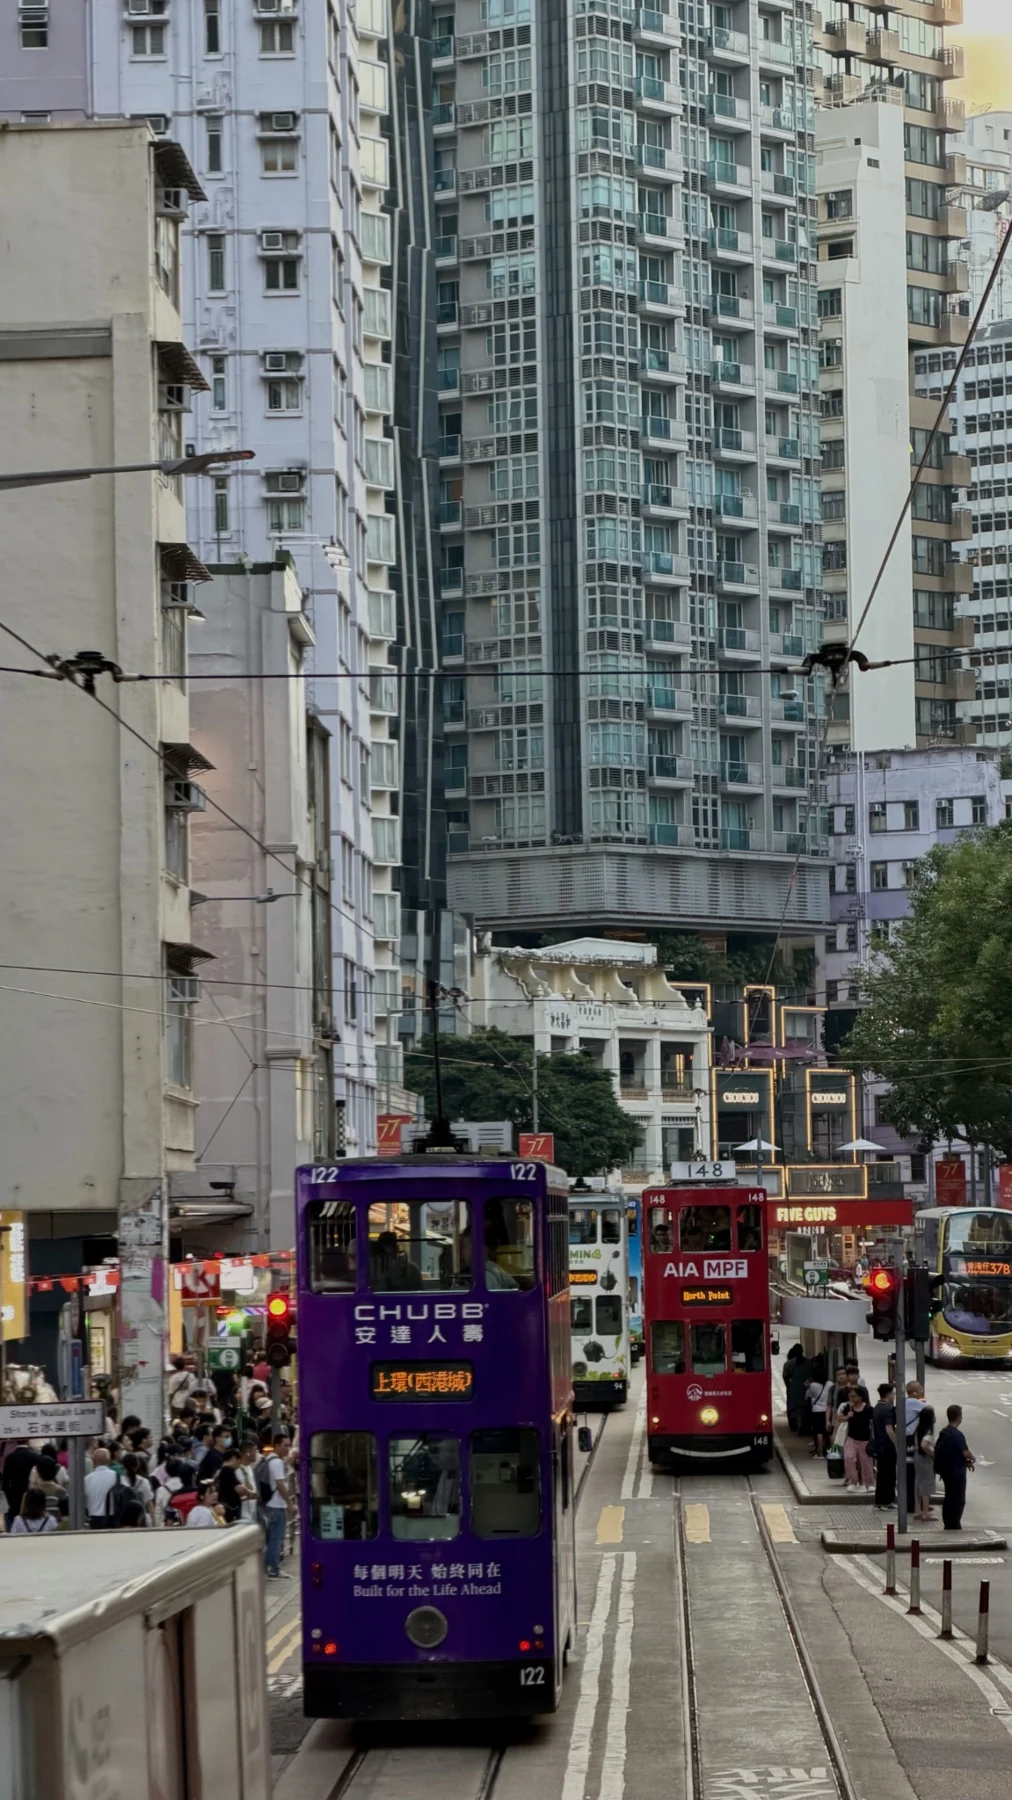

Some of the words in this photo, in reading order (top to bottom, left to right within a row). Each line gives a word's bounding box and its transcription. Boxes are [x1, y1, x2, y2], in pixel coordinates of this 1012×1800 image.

[312, 1166, 339, 1184] 122
[511, 1163, 537, 1181] 122
[688, 1163, 723, 1178] 148
[650, 1195, 666, 1205] 148
[748, 1193, 765, 1203] 148
[777, 1207, 803, 1222] FIVE
[804, 1206, 837, 1222] GUYS
[664, 1262, 699, 1277] AIA
[707, 1262, 745, 1276] MPF
[990, 1263, 1010, 1275] 37B
[683, 1291, 706, 1301] North
[708, 1291, 730, 1301] Point
[354, 1303, 484, 1320] CHUBB
[355, 1324, 484, 1344] 安達人壽
[10, 1410, 38, 1418] Stone
[40, 1408, 72, 1417] Nullah
[73, 1407, 97, 1416] Lane
[753, 1436, 768, 1446] 148
[353, 1564, 423, 1580] 每個明天
[431, 1561, 501, 1579] 始終同在
[353, 1585, 383, 1597] Built
[386, 1584, 406, 1597] for
[408, 1583, 430, 1597] the
[433, 1583, 458, 1596] Life
[461, 1582, 501, 1596] Ahead
[520, 1666, 546, 1685] 122
